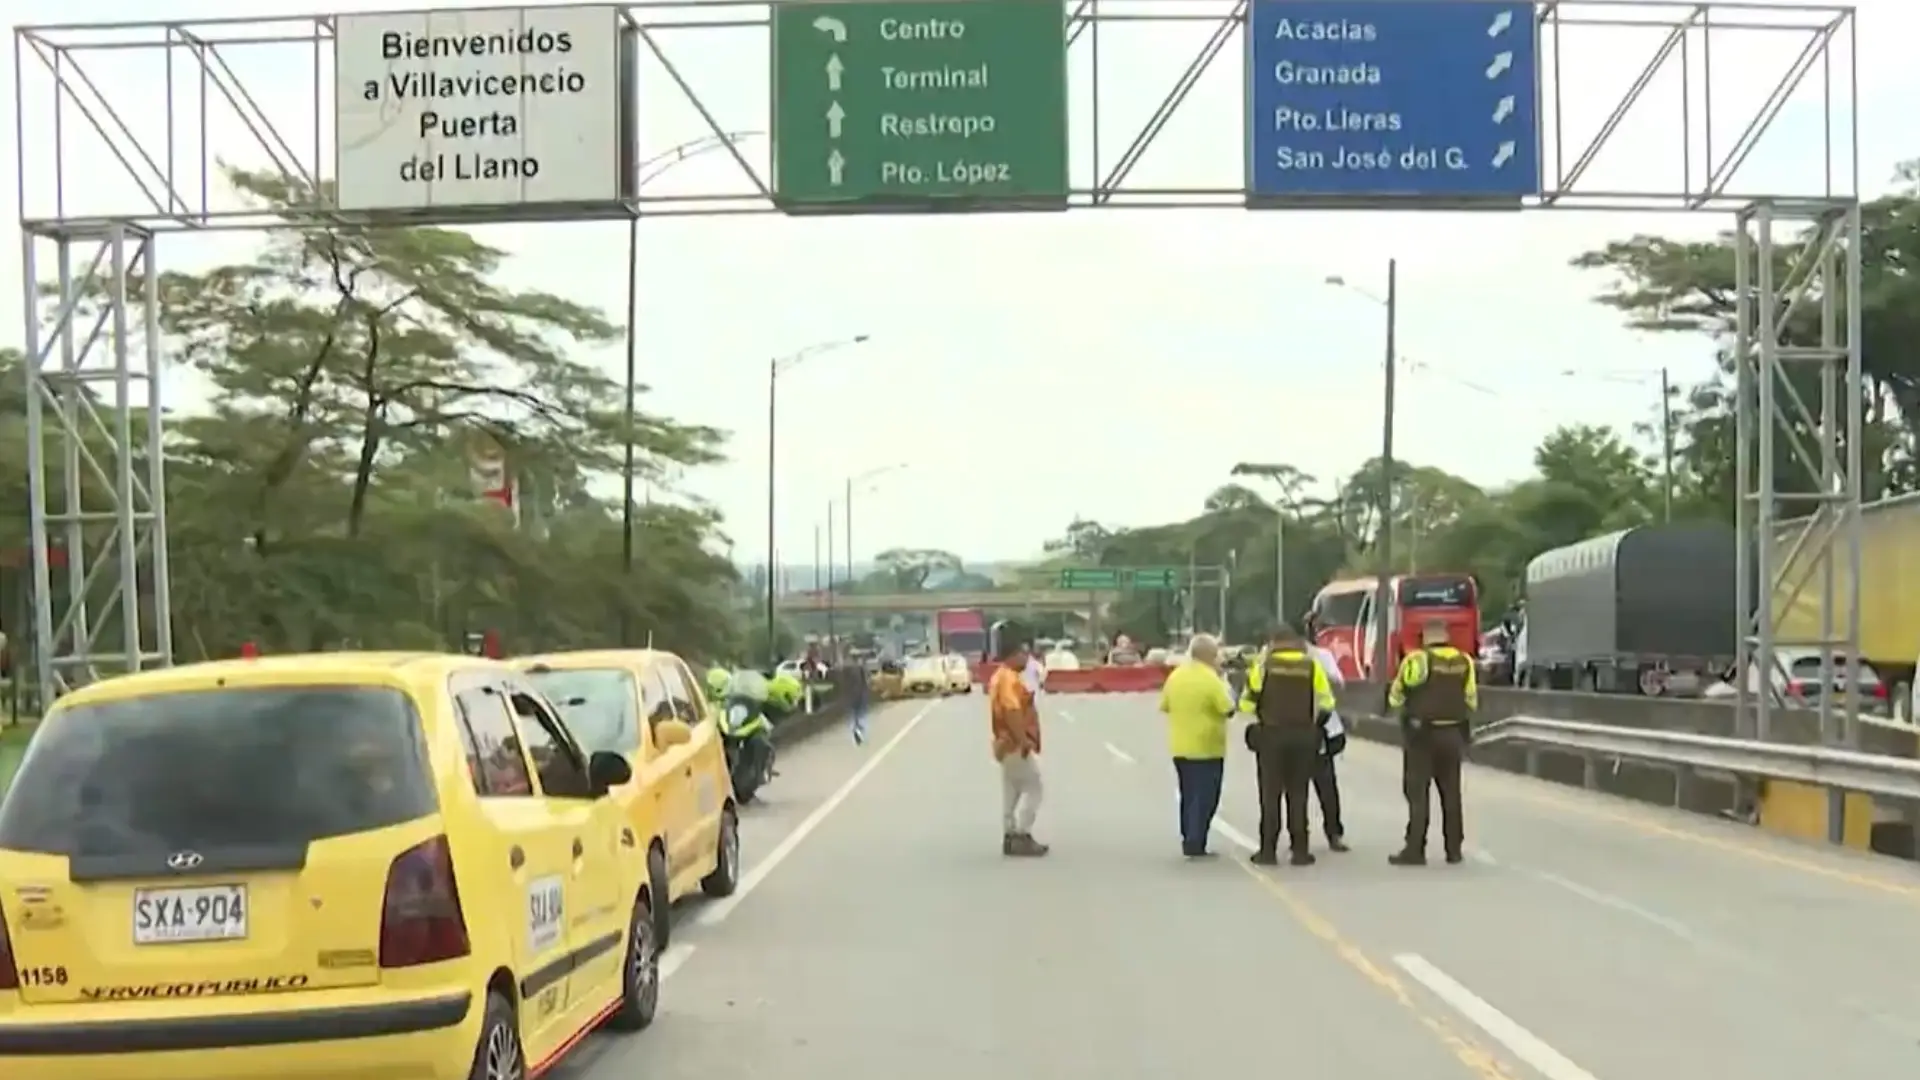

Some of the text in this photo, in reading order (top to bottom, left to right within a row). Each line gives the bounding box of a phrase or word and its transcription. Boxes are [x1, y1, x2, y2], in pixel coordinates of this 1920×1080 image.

[880, 18, 965, 40] Centro
[382, 27, 573, 59] Bienvenidos
[364, 66, 585, 100] a Villavicencio
[880, 61, 988, 90] Terminal
[1275, 60, 1381, 85] Granada
[420, 111, 517, 138] Puerta
[880, 113, 995, 138] Restrepo
[400, 153, 539, 182] del Llano
[1277, 144, 1470, 170] San José del G.
[882, 159, 1011, 185] Pto. López
[18, 966, 68, 987] 1158
